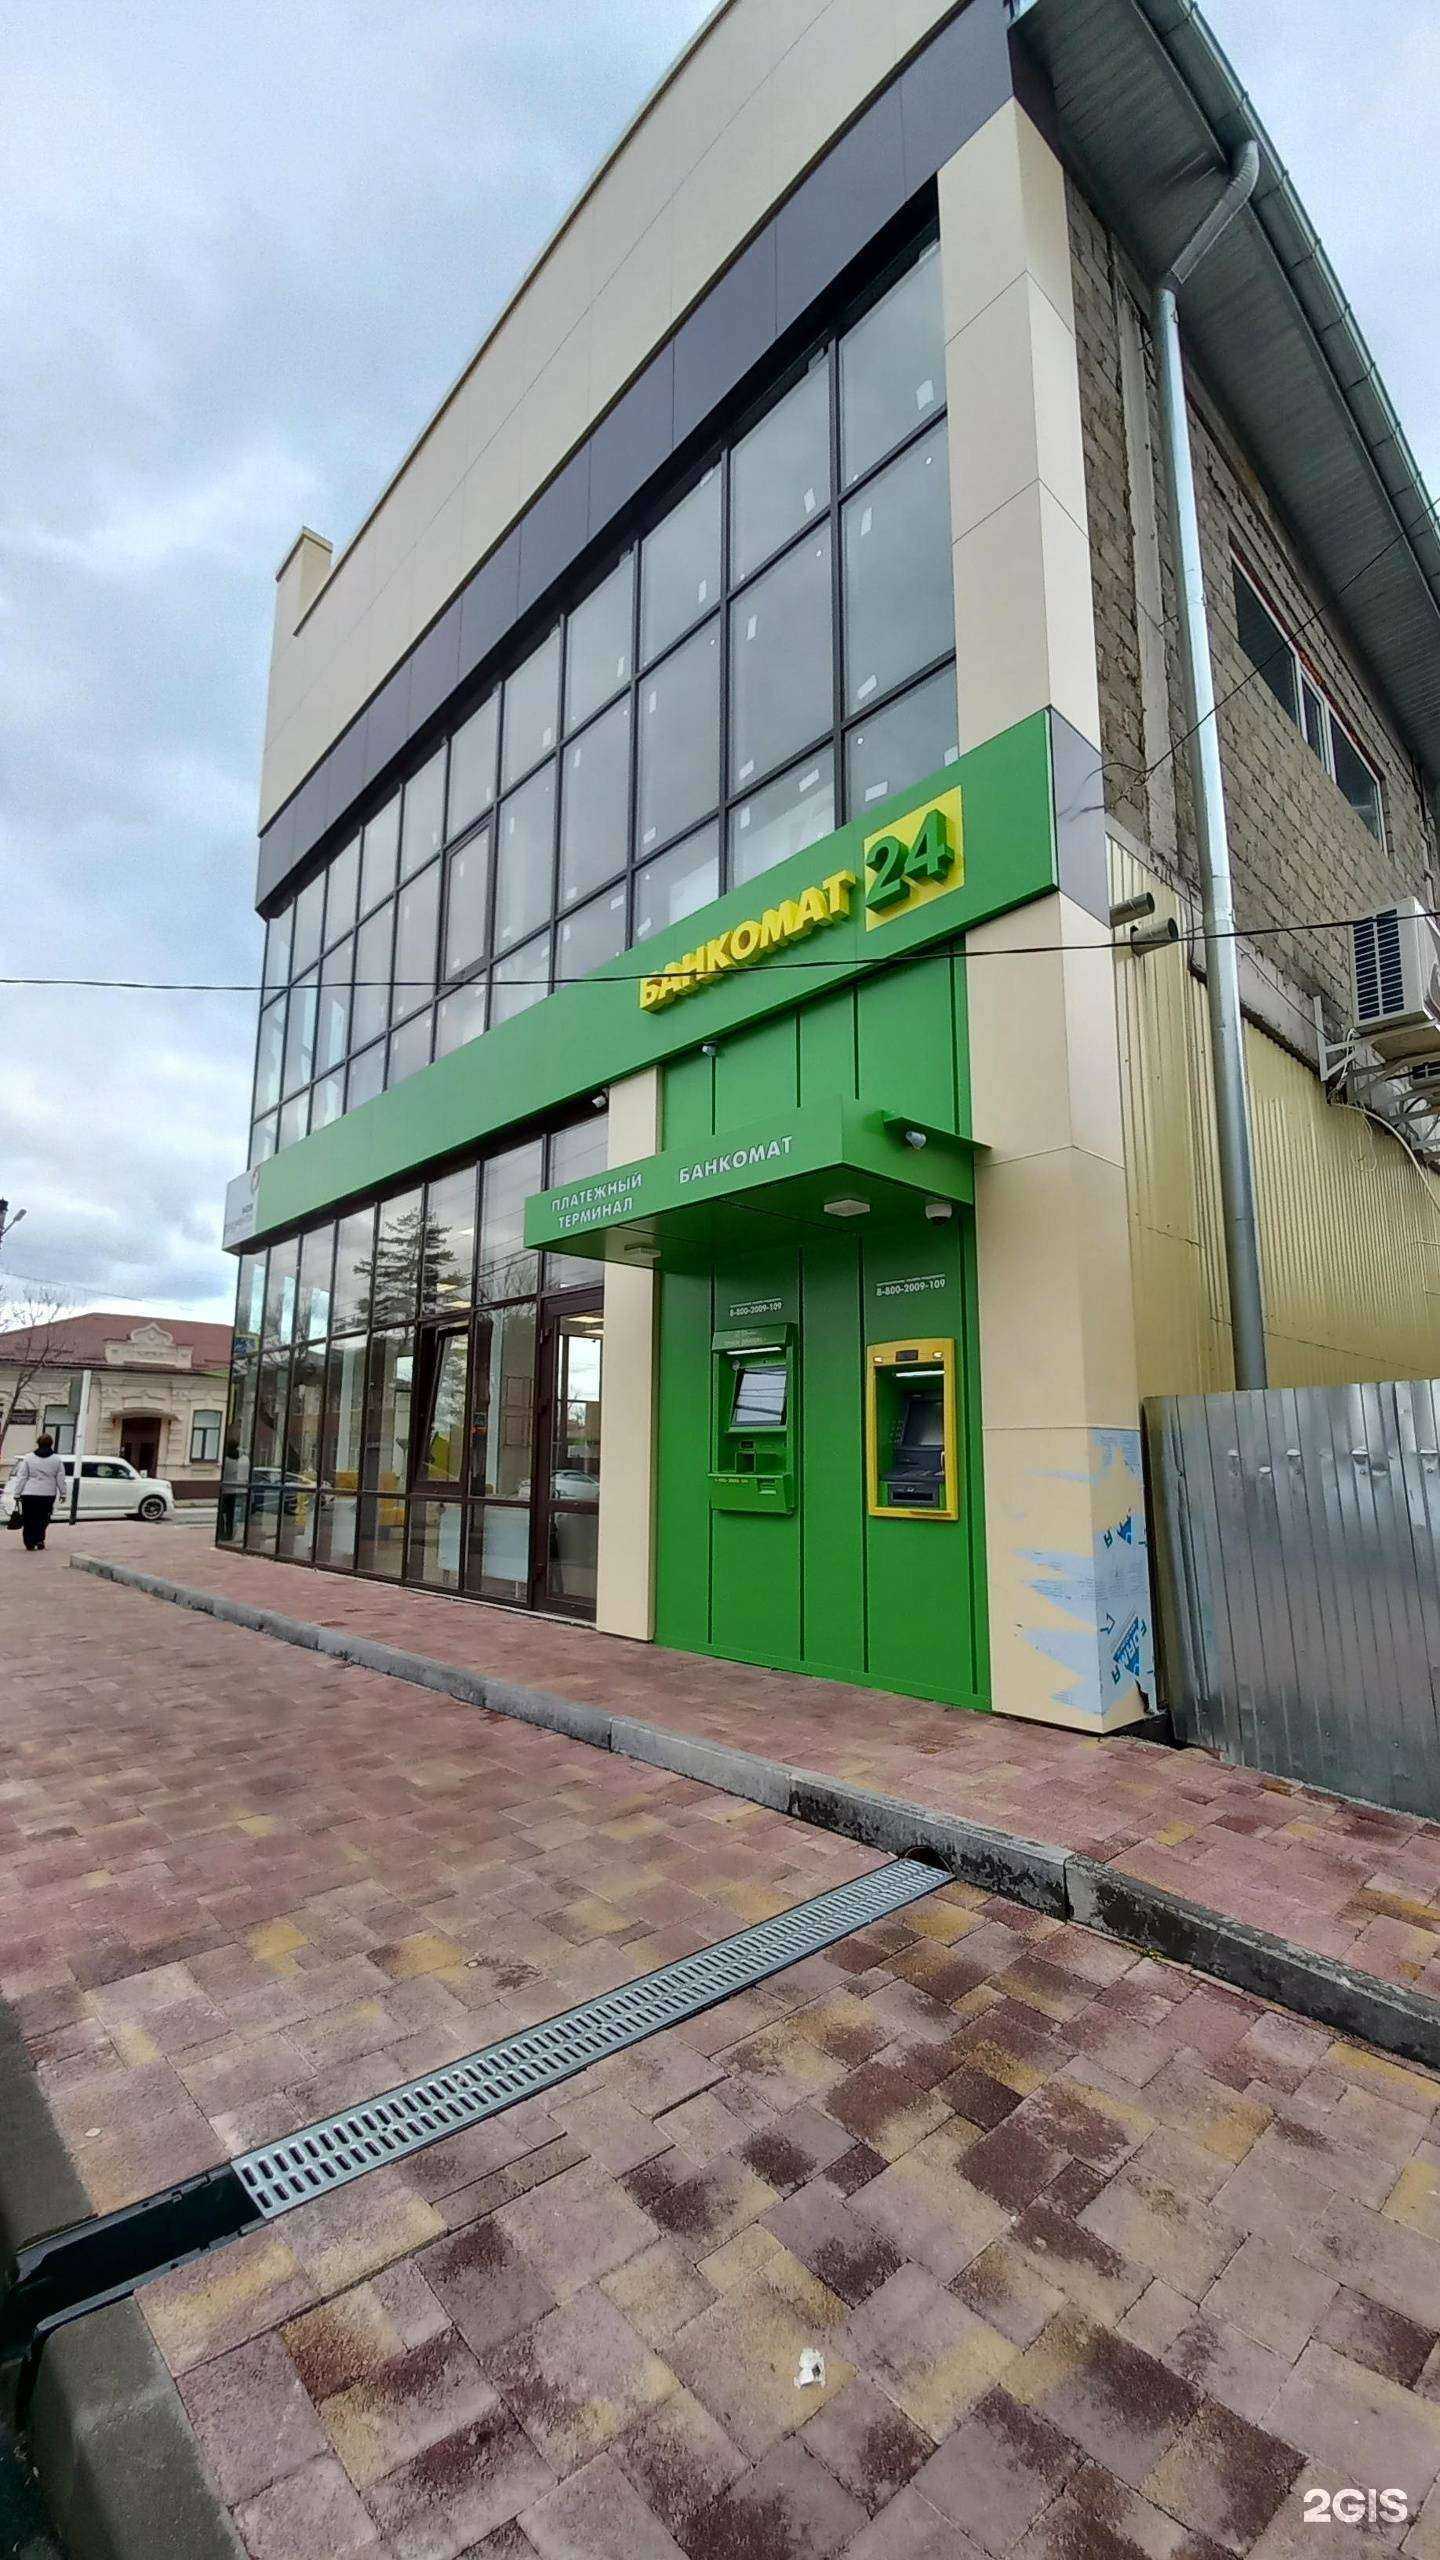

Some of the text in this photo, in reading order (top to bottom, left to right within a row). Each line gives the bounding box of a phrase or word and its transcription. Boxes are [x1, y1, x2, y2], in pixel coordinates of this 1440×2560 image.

[639, 808, 954, 1014] БАНКОМАТ 24
[679, 1135, 793, 1184] БАНКОМАТ
[551, 1171, 643, 1212] ПЛАТЕЖНЫЙ
[558, 1197, 633, 1229] ТЕРМИНАЛ
[876, 1278, 946, 1296] 8-800-2009-109
